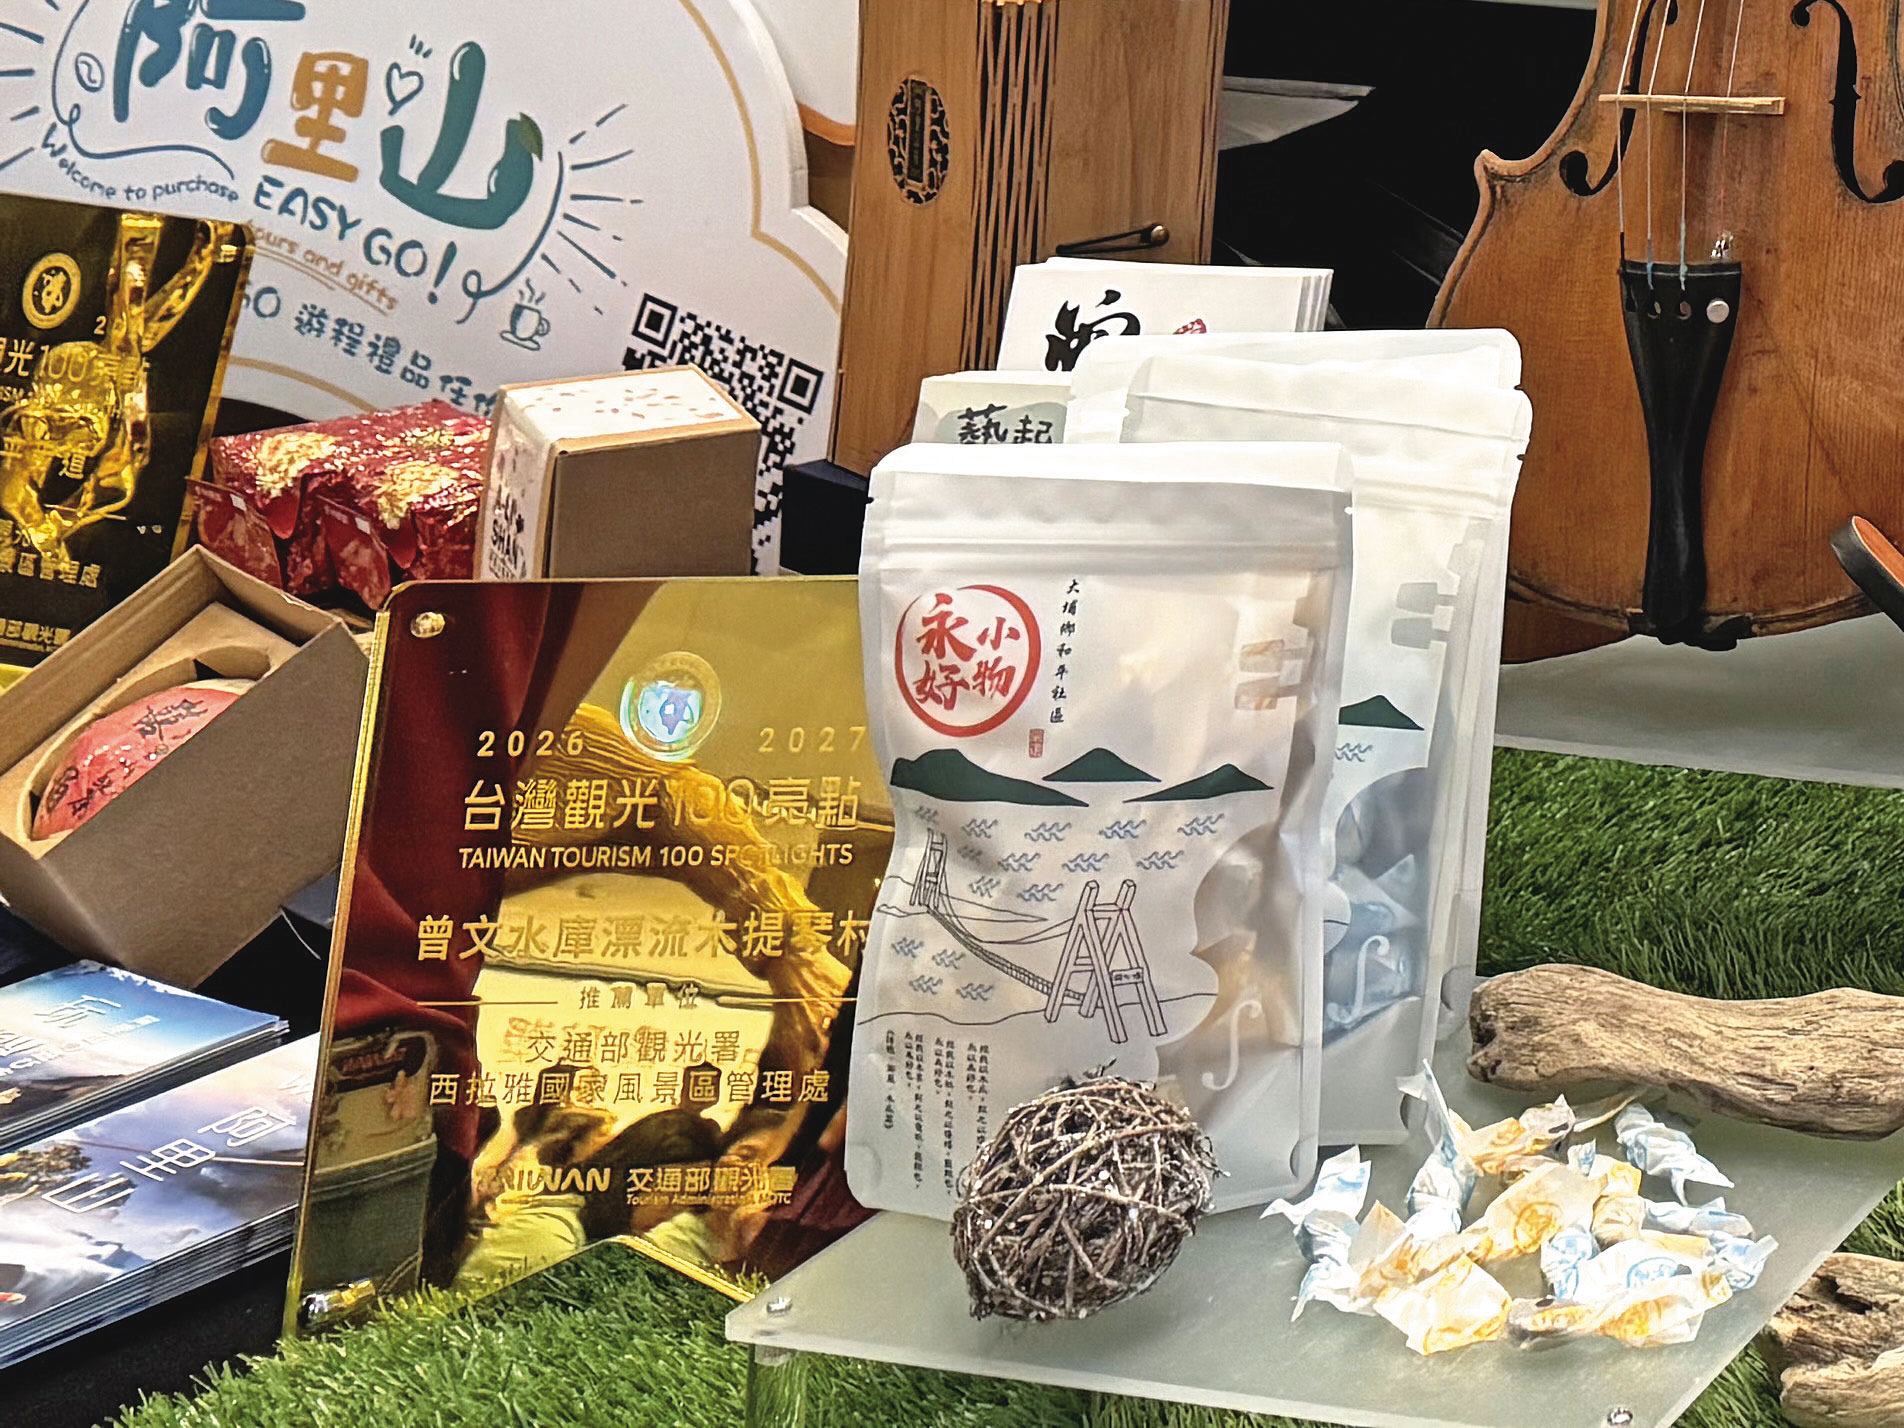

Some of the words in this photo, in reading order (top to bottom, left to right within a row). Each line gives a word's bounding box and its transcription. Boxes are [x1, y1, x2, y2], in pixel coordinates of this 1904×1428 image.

[41, 122, 117, 199] Welcome
[123, 185, 147, 201] to
[152, 173, 239, 202] purchase
[254, 174, 362, 241] EASY
[363, 227, 458, 305] GO!
[302, 246, 344, 278] and
[346, 271, 399, 311] gifts
[1050, 579, 1080, 723] 大埔鄉和平社區
[476, 729, 584, 757] 2026
[759, 726, 866, 753] 2027
[464, 775, 859, 832] 台灣觀光100亮點
[459, 846, 545, 869] TAIWAN
[550, 846, 652, 868] TOURISM
[660, 845, 704, 867] 100
[710, 843, 854, 866] SPOTLIGHTS
[527, 1029, 741, 1065] 交通部觀光署
[429, 1069, 832, 1107] 西拉雅國家風景區管理處
[42, 1106, 297, 1214] 阿里山
